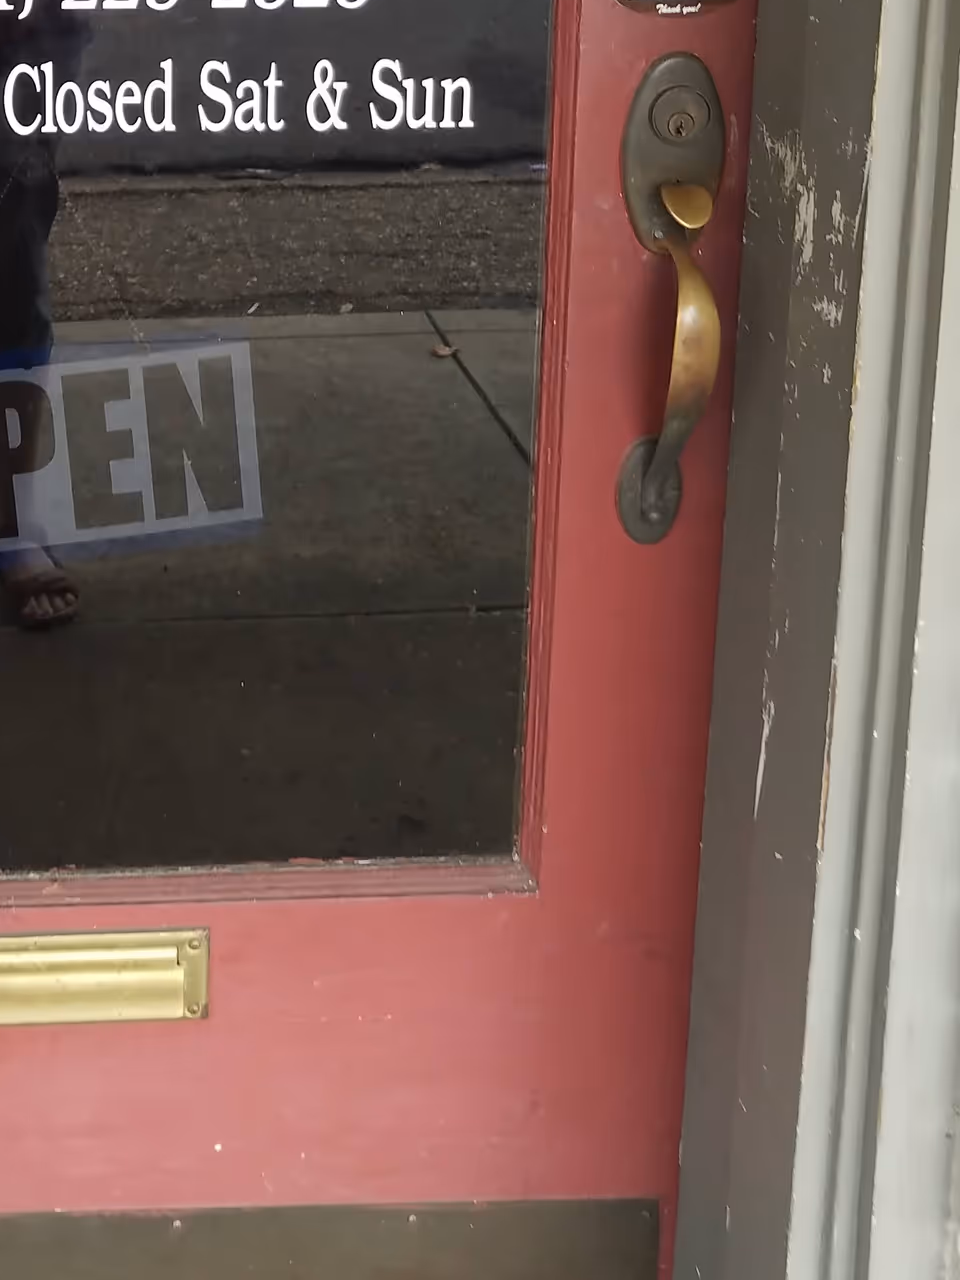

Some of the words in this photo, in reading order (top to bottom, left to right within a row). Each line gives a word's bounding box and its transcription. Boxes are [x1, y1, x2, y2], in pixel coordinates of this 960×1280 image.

[3, 58, 176, 136] Closed
[198, 60, 284, 132] Sat
[306, 58, 348, 132] &
[369, 58, 474, 130] Sun
